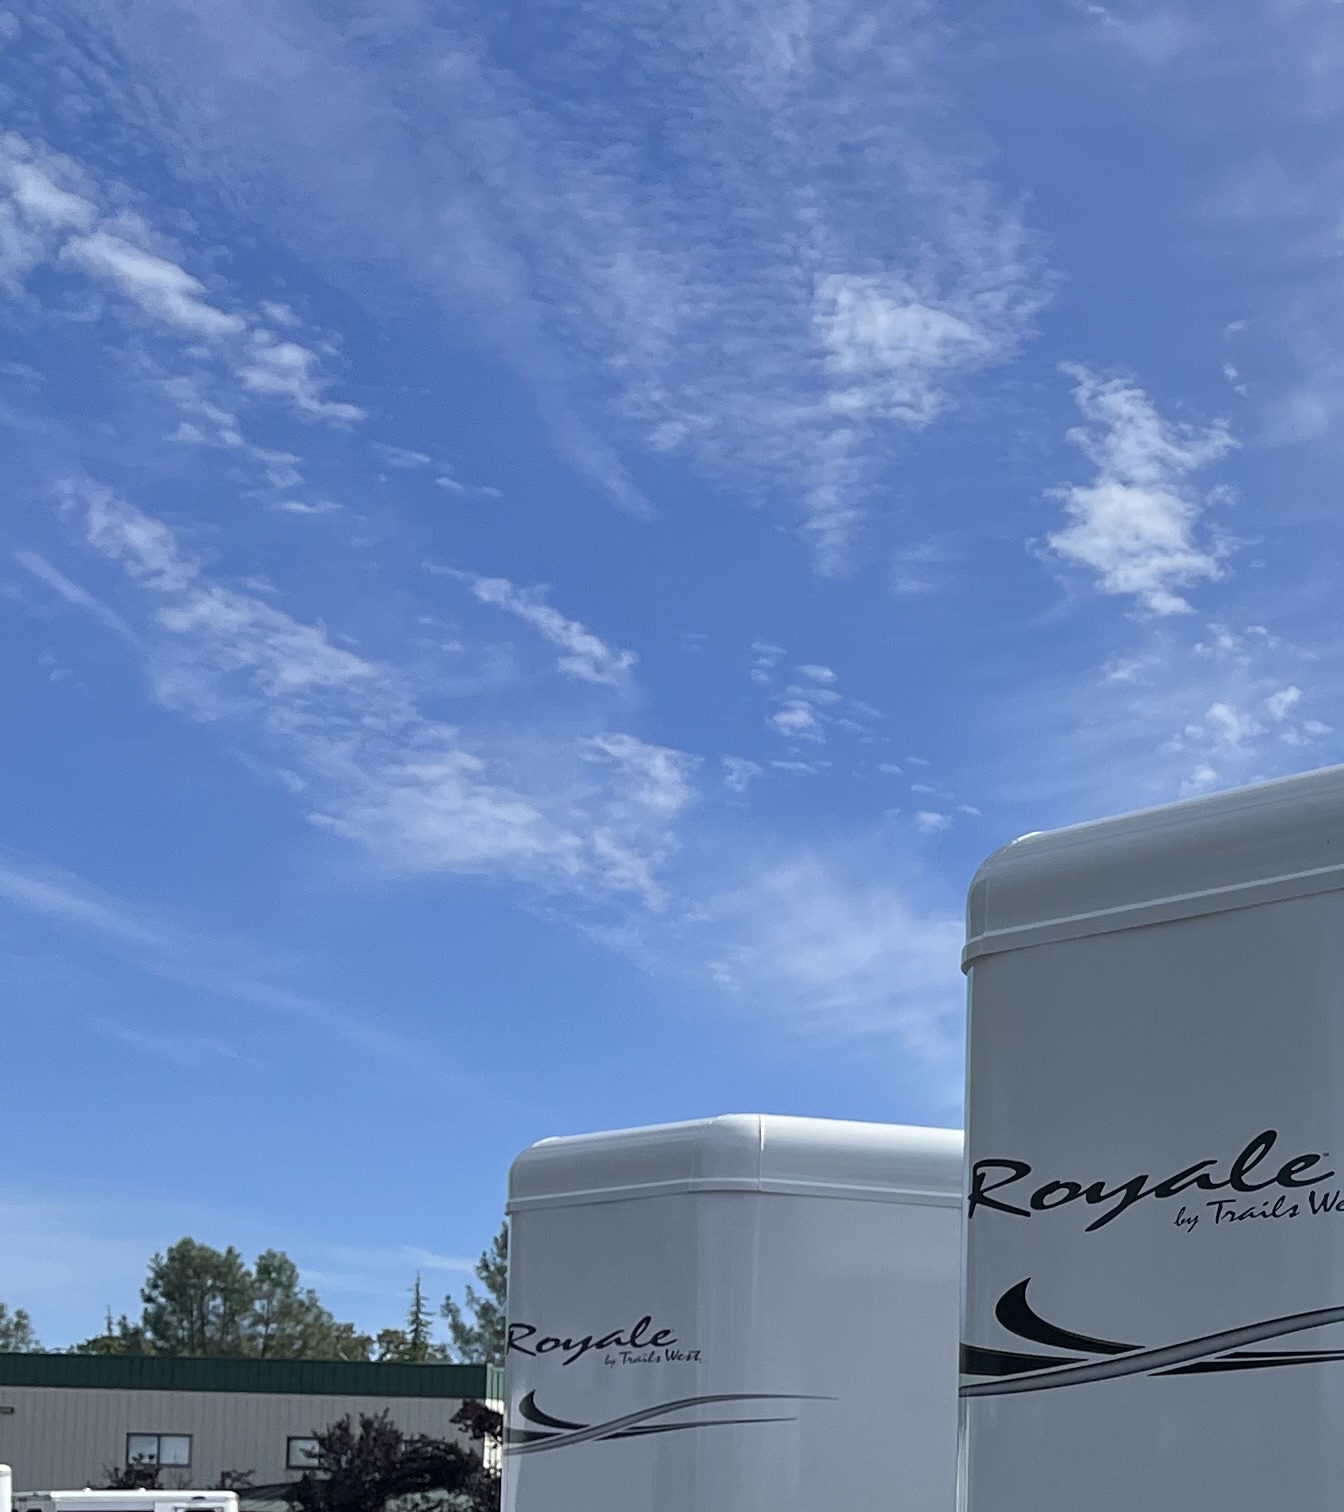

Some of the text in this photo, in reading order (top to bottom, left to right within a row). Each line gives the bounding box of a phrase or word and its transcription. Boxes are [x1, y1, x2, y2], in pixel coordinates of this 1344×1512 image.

[968, 1130, 1335, 1232] Royale
[1174, 1206, 1200, 1233] by
[1206, 1195, 1300, 1224] Trails
[507, 1316, 678, 1366] Royale
